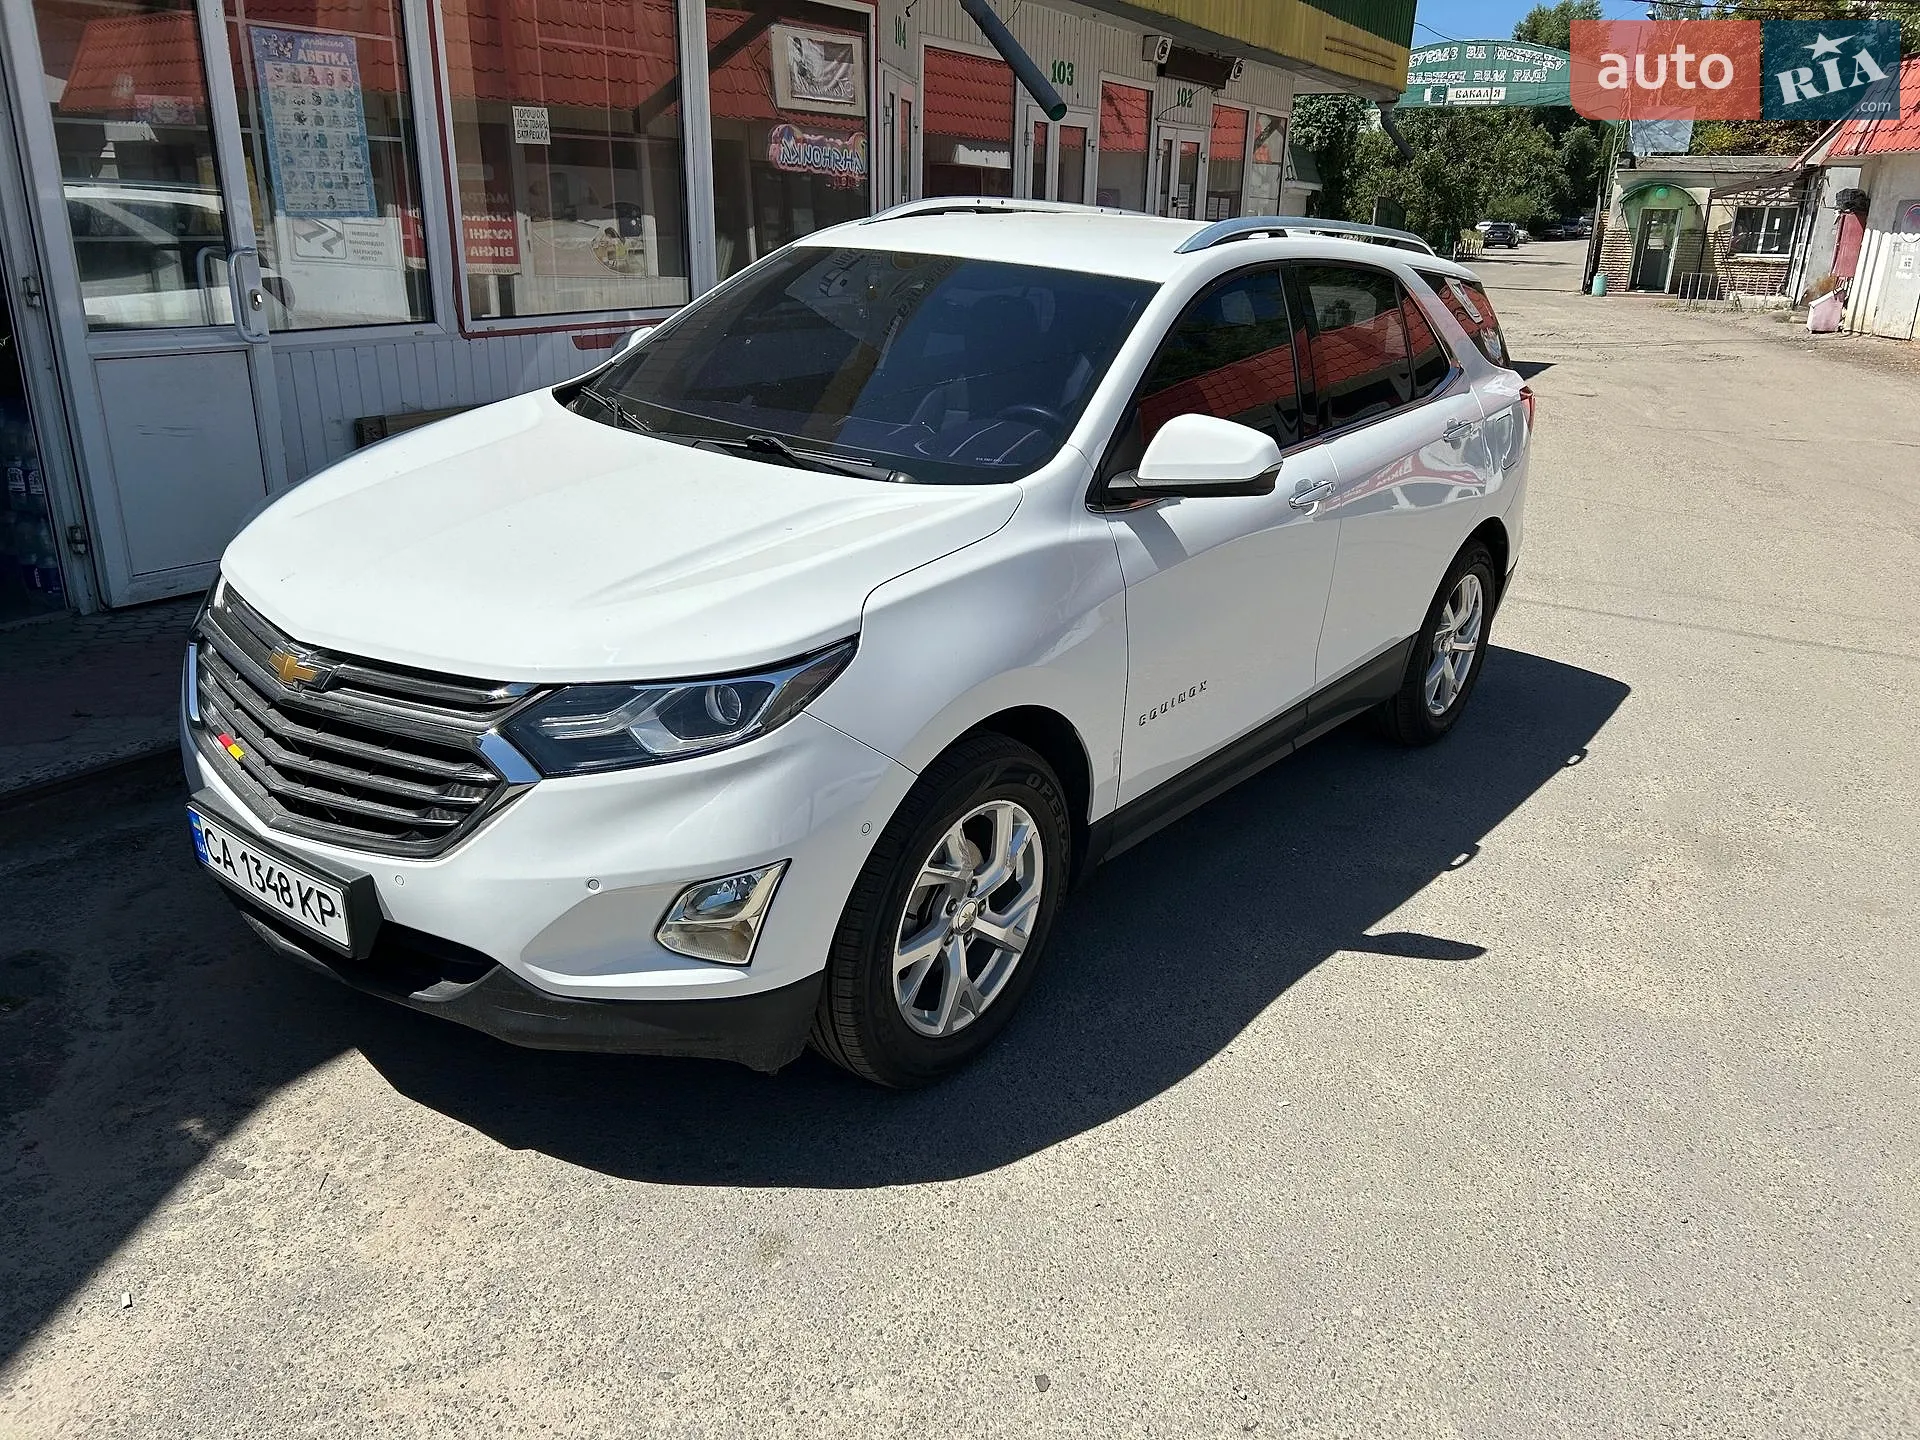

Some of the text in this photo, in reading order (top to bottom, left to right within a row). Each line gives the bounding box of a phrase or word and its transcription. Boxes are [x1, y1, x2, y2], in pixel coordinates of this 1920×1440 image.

[894, 14, 907, 50] 104
[298, 49, 350, 66] АБЕТКА
[1051, 60, 1074, 86] 103
[1176, 87, 1193, 108] 102
[1139, 679, 1208, 727] EQUINOX
[196, 840, 207, 856] UA
[204, 827, 336, 928] CA 1348 KP
